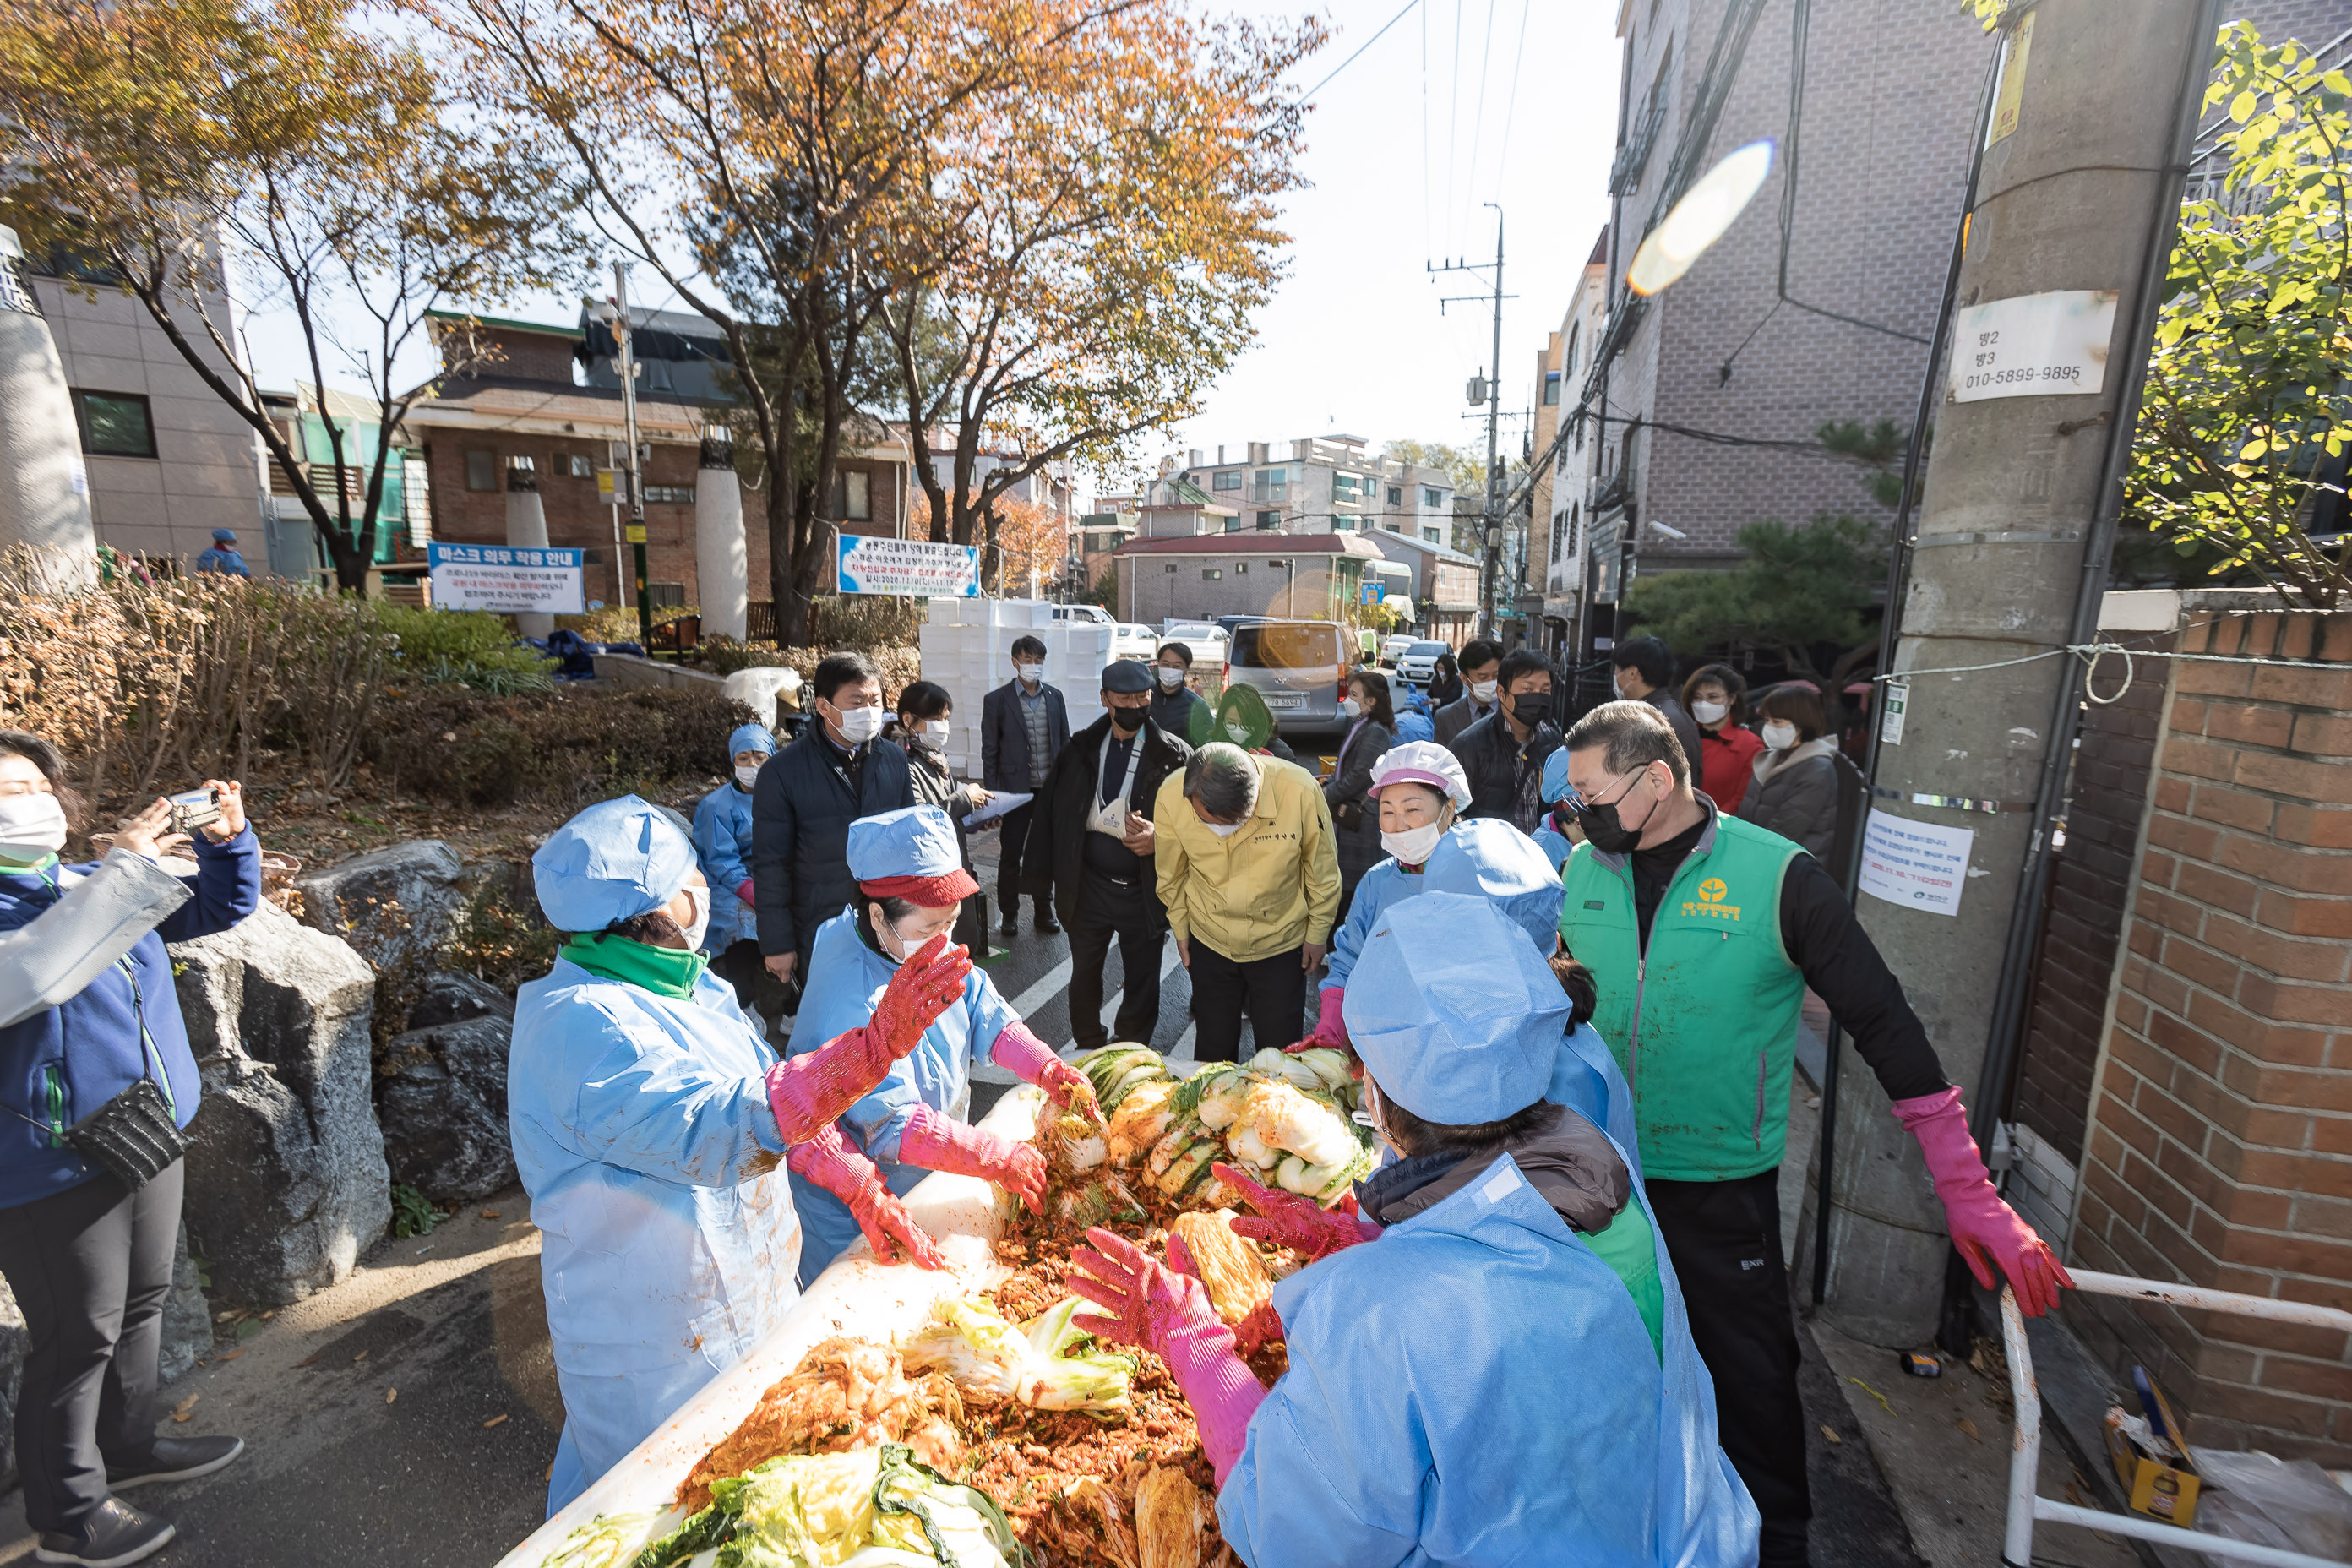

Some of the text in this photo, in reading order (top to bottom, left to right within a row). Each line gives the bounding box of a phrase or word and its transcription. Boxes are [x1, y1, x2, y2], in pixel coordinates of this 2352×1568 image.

[1979, 331, 2000, 347] 방2
[1975, 351, 1995, 368] 방3
[1966, 366, 2081, 389] 010-5899-9895
[438, 547, 574, 567] 마스크 의무 착용 안내
[1740, 1258, 1765, 1271] EXR
